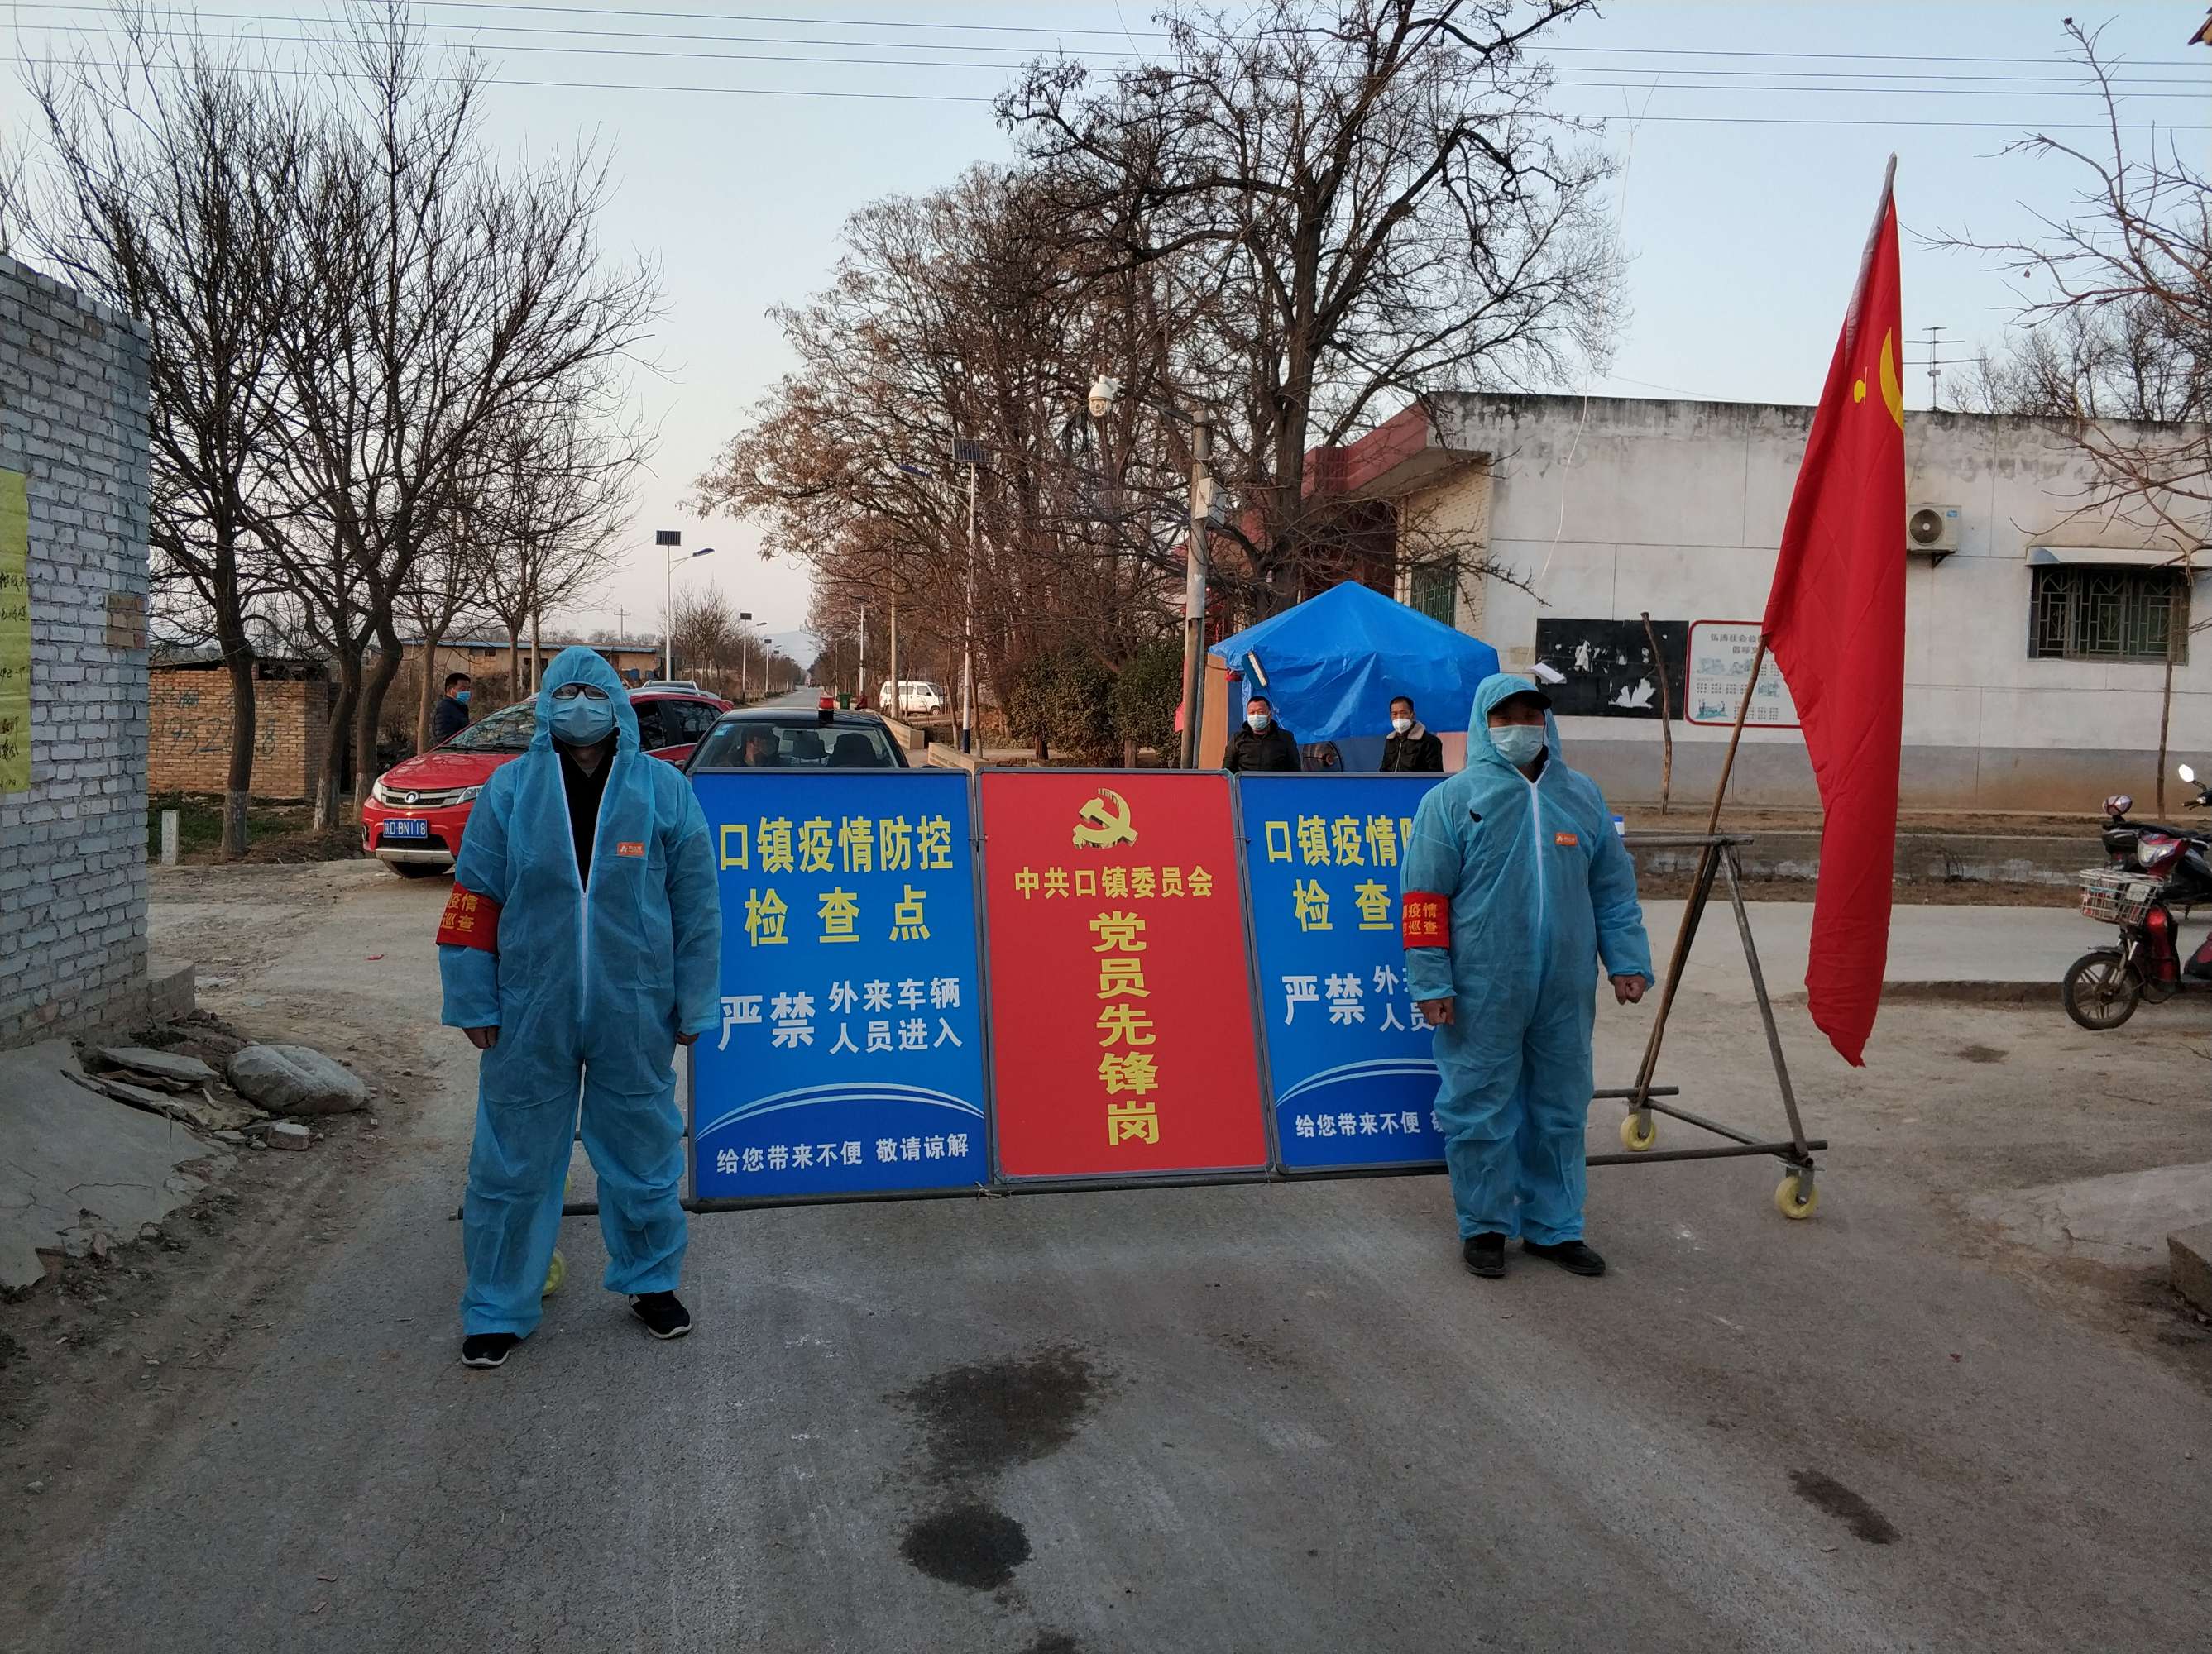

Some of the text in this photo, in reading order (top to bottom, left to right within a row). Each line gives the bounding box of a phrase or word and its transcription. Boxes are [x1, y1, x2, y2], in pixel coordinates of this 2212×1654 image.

[719, 815, 954, 874] 口镇疫情防控
[1014, 865, 1214, 900] 中共口镇委员会
[1293, 879, 1395, 933] 检查
[745, 884, 931, 947] 检查点
[828, 977, 960, 1014] 外来车辆
[1281, 973, 1366, 1026] 严禁
[1372, 964, 1408, 996] 外
[717, 992, 816, 1052] 严禁
[829, 1018, 963, 1054] 人员进入
[1089, 911, 1160, 1146] 党员先锋岗
[1295, 1111, 1421, 1138] 给您带来不便
[716, 1132, 970, 1174] 给您带来不便 敬请谅解
